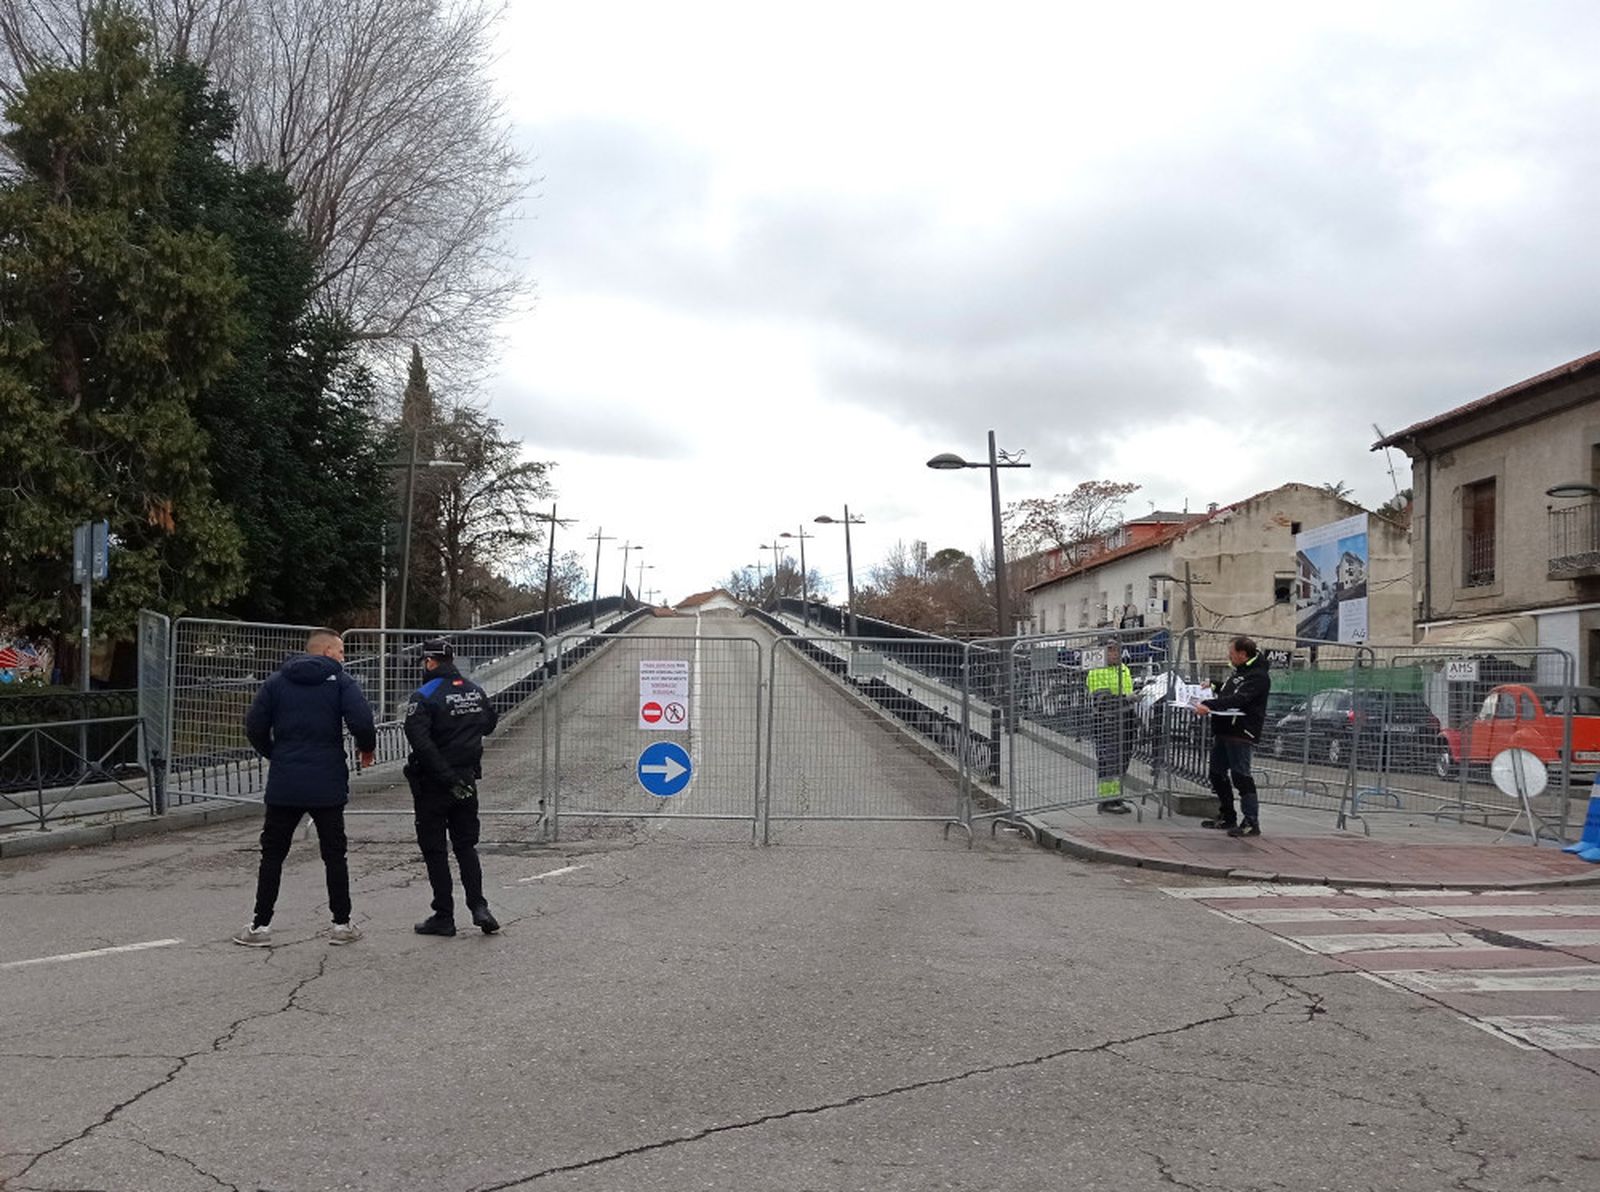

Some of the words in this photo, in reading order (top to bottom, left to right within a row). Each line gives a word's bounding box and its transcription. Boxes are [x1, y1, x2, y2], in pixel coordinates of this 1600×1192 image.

[1267, 651, 1288, 661] AMS
[1450, 663, 1473, 673] AMS
[445, 689, 482, 704] POLICÍA
